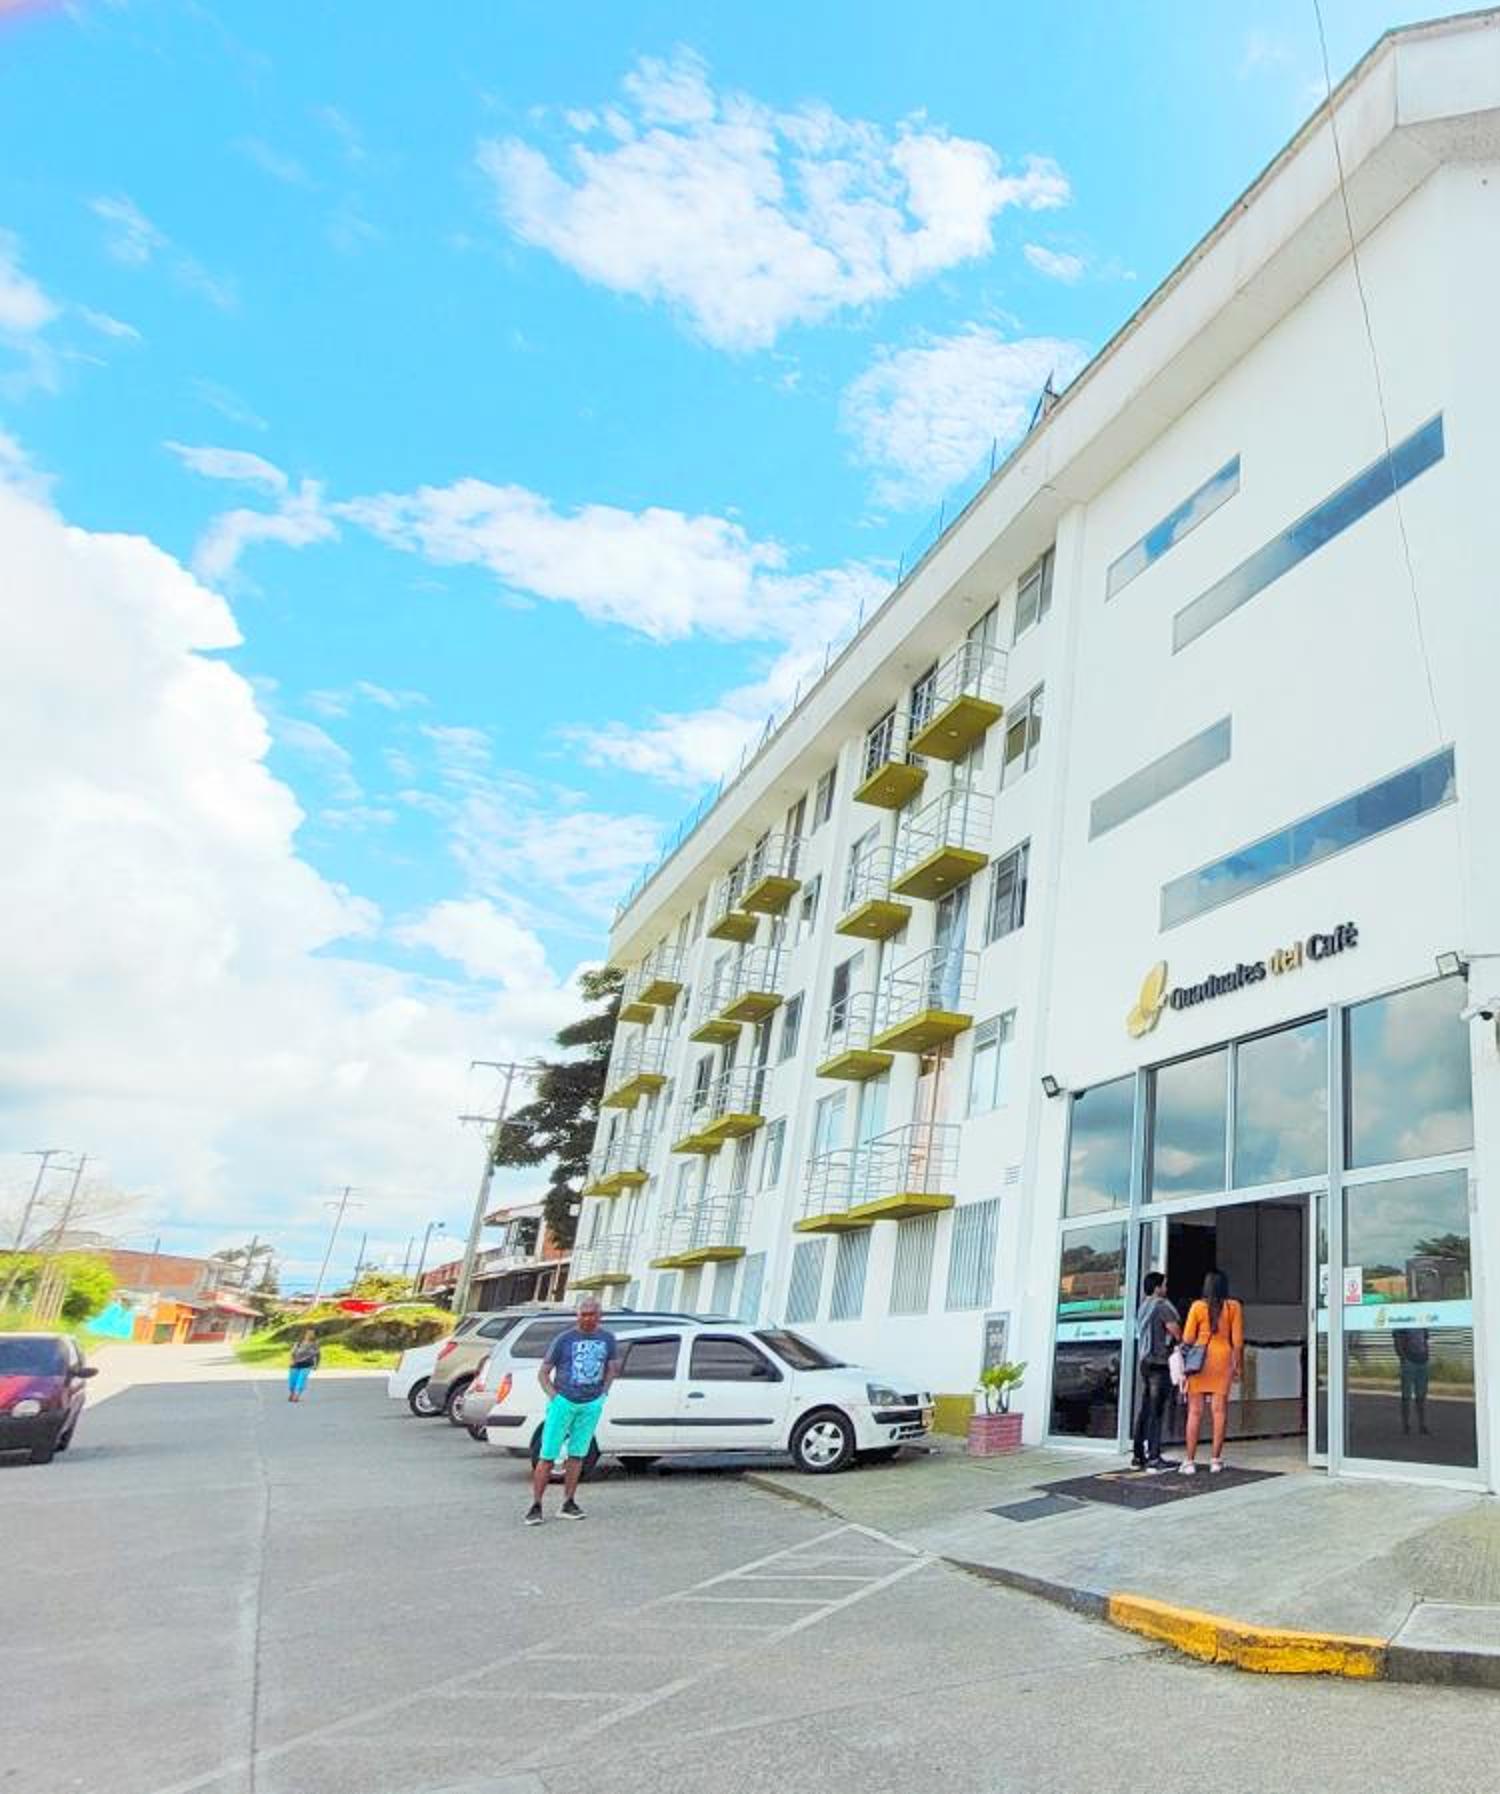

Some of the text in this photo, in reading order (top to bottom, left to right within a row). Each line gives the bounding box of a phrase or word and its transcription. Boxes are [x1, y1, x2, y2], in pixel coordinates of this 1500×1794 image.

[1170, 921, 1359, 1011] Guaduales del Café
